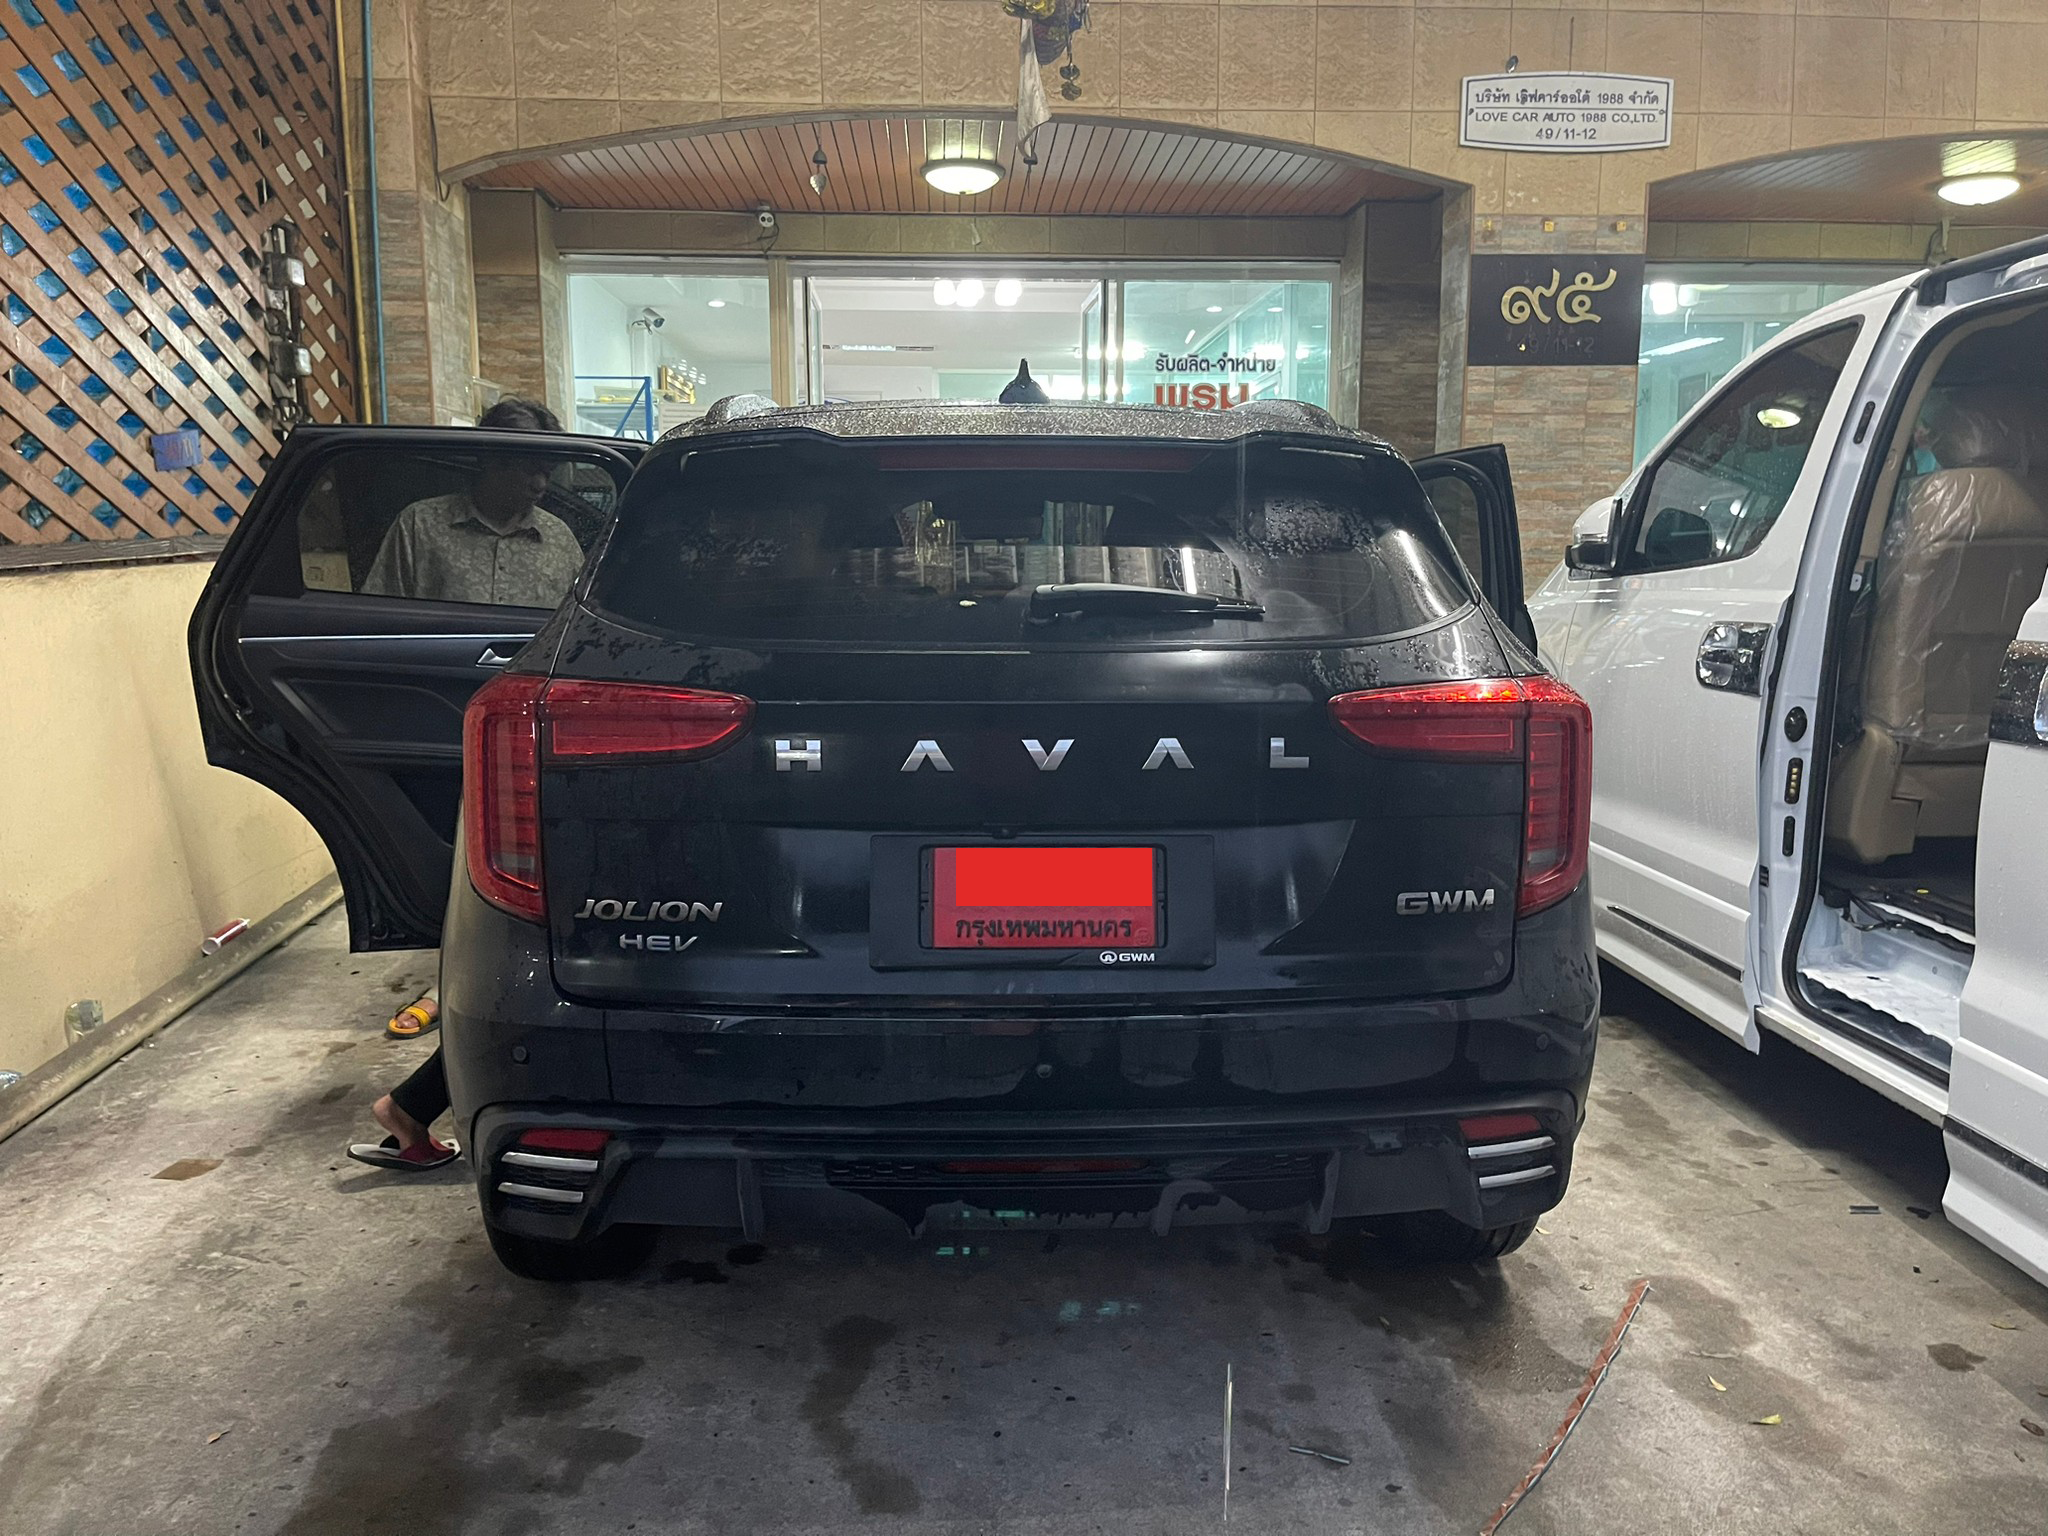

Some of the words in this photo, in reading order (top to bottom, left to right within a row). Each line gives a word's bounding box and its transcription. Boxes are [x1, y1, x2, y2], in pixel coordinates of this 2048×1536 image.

[1475, 87, 1510, 103] บริษัท
[1597, 92, 1623, 104] 1988
[1628, 90, 1659, 104] จำกัด
[1475, 112, 1507, 122] LOVE
[1512, 112, 1539, 122] CAR
[1542, 113, 1576, 123] AUTO
[1581, 112, 1607, 123] 1988
[1501, 268, 1617, 325] ๙๕
[1155, 352, 1276, 372] รับผลิต-จำหน่าย
[775, 737, 1310, 772] HAVAL
[574, 899, 723, 923] JOLION
[1396, 888, 1495, 915] GWM
[619, 934, 698, 952] HEV
[955, 919, 1132, 945] กรุงเทพมหานคร
[1119, 953, 1155, 962] GWM
